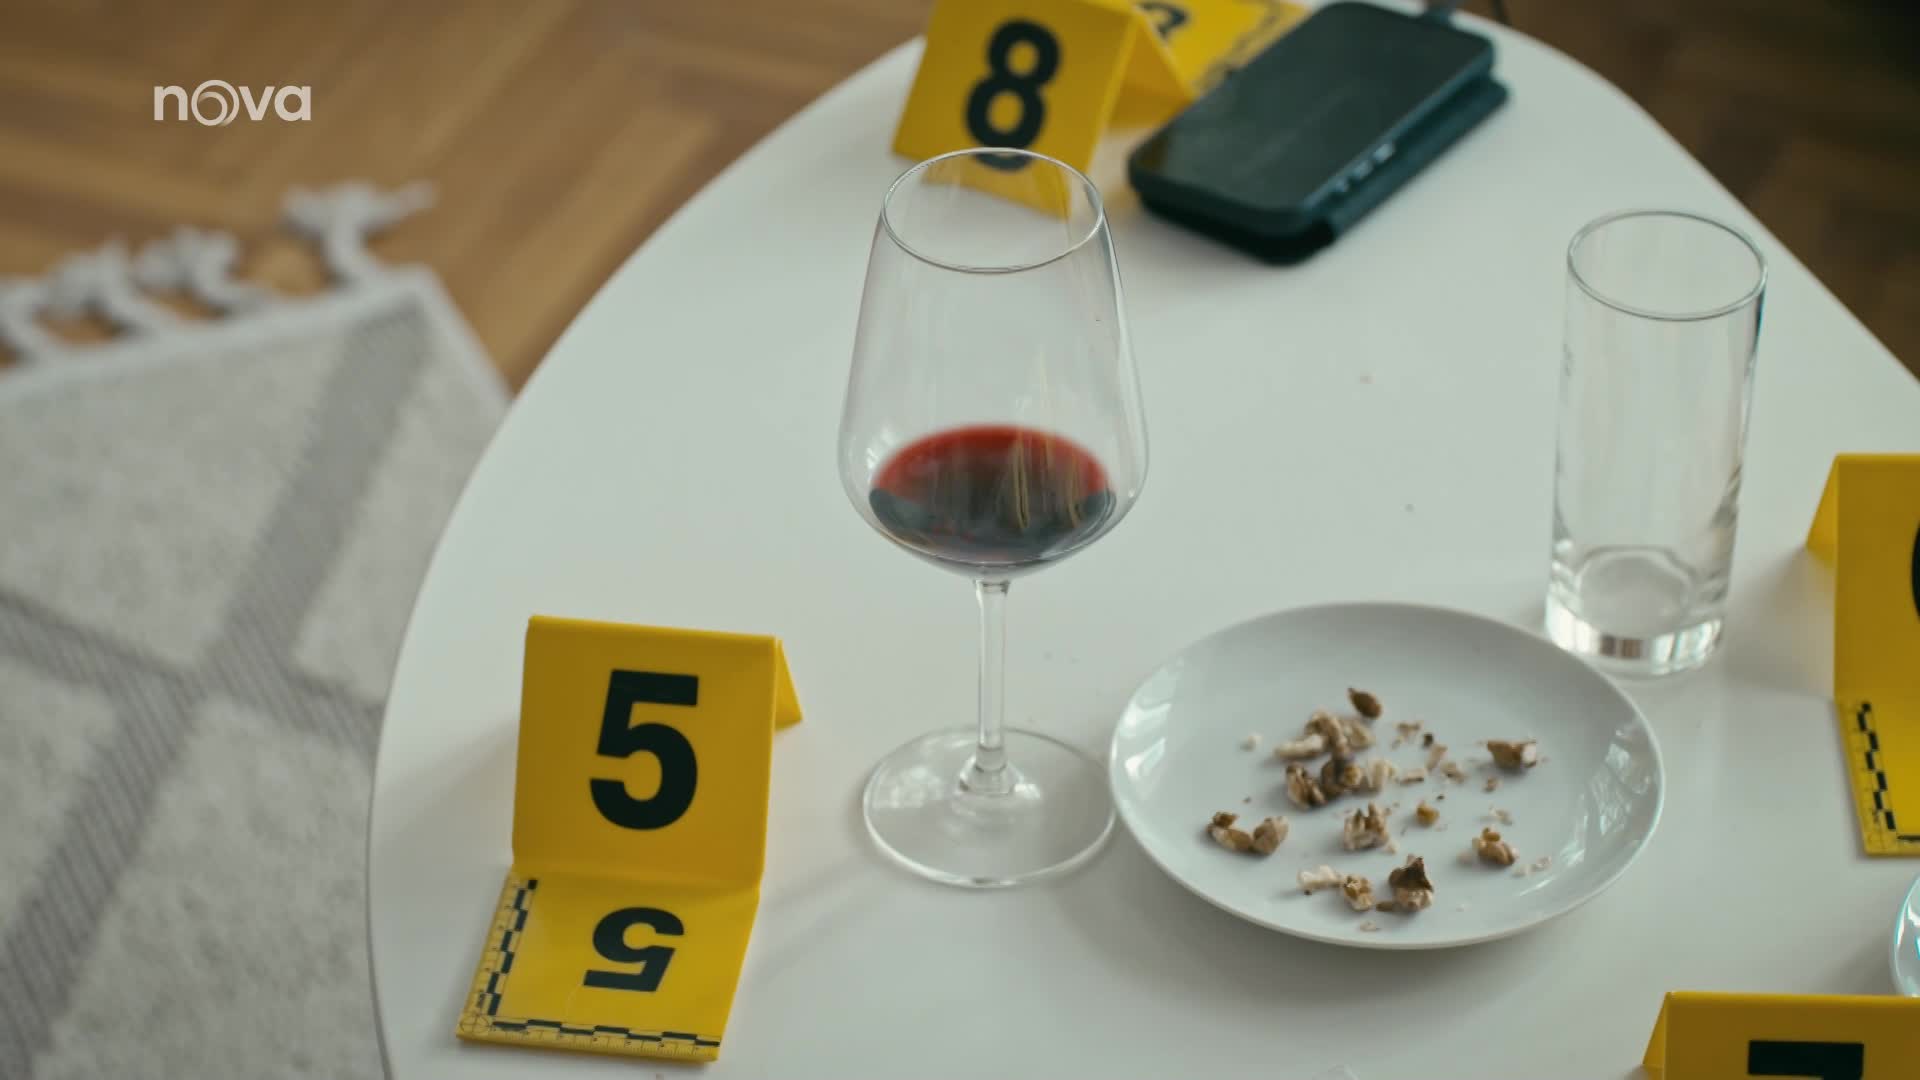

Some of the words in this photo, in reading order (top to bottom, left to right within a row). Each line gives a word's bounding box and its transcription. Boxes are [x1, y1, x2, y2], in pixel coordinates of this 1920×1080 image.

[966, 18, 1061, 170] 8
[589, 669, 699, 830] 5
[582, 906, 685, 992] 5
